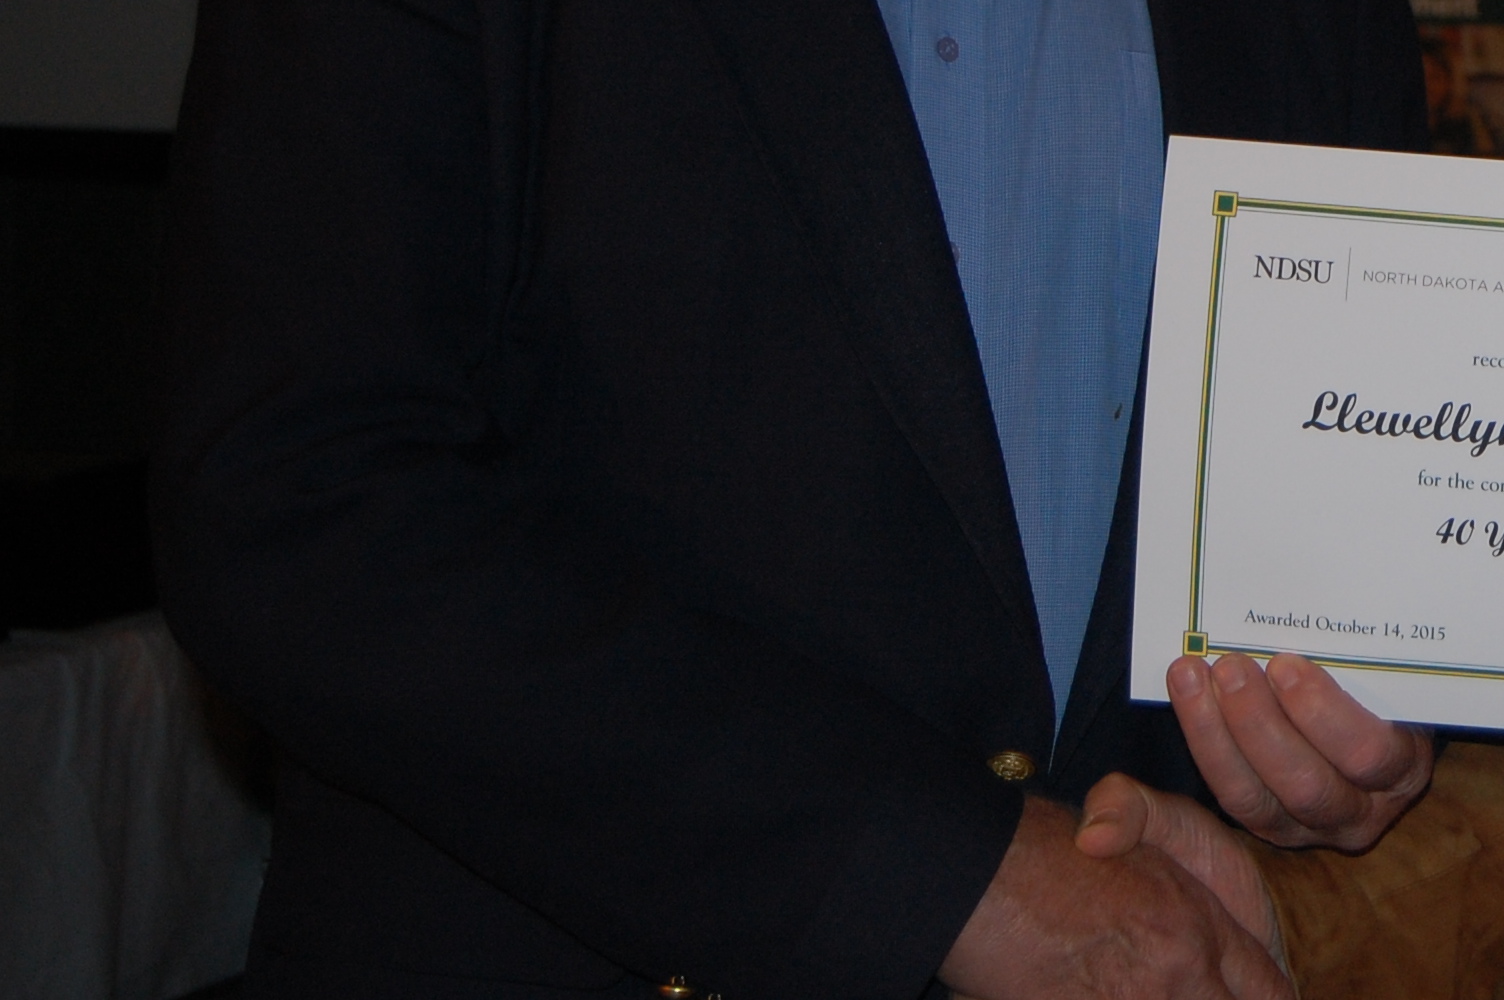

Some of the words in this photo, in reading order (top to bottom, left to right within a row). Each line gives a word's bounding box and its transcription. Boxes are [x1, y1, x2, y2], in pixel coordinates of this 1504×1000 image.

[1253, 255, 1334, 284] NDSU
[1363, 269, 1417, 286] NORTH
[1422, 275, 1488, 292] DAKOTA
[1418, 470, 1442, 487] for
[1447, 473, 1475, 491] the
[1435, 517, 1476, 546] 40
[1244, 609, 1310, 629] Awarded
[1316, 616, 1377, 636] October
[1384, 622, 1405, 640] 14,
[1411, 624, 1446, 641] 2015
